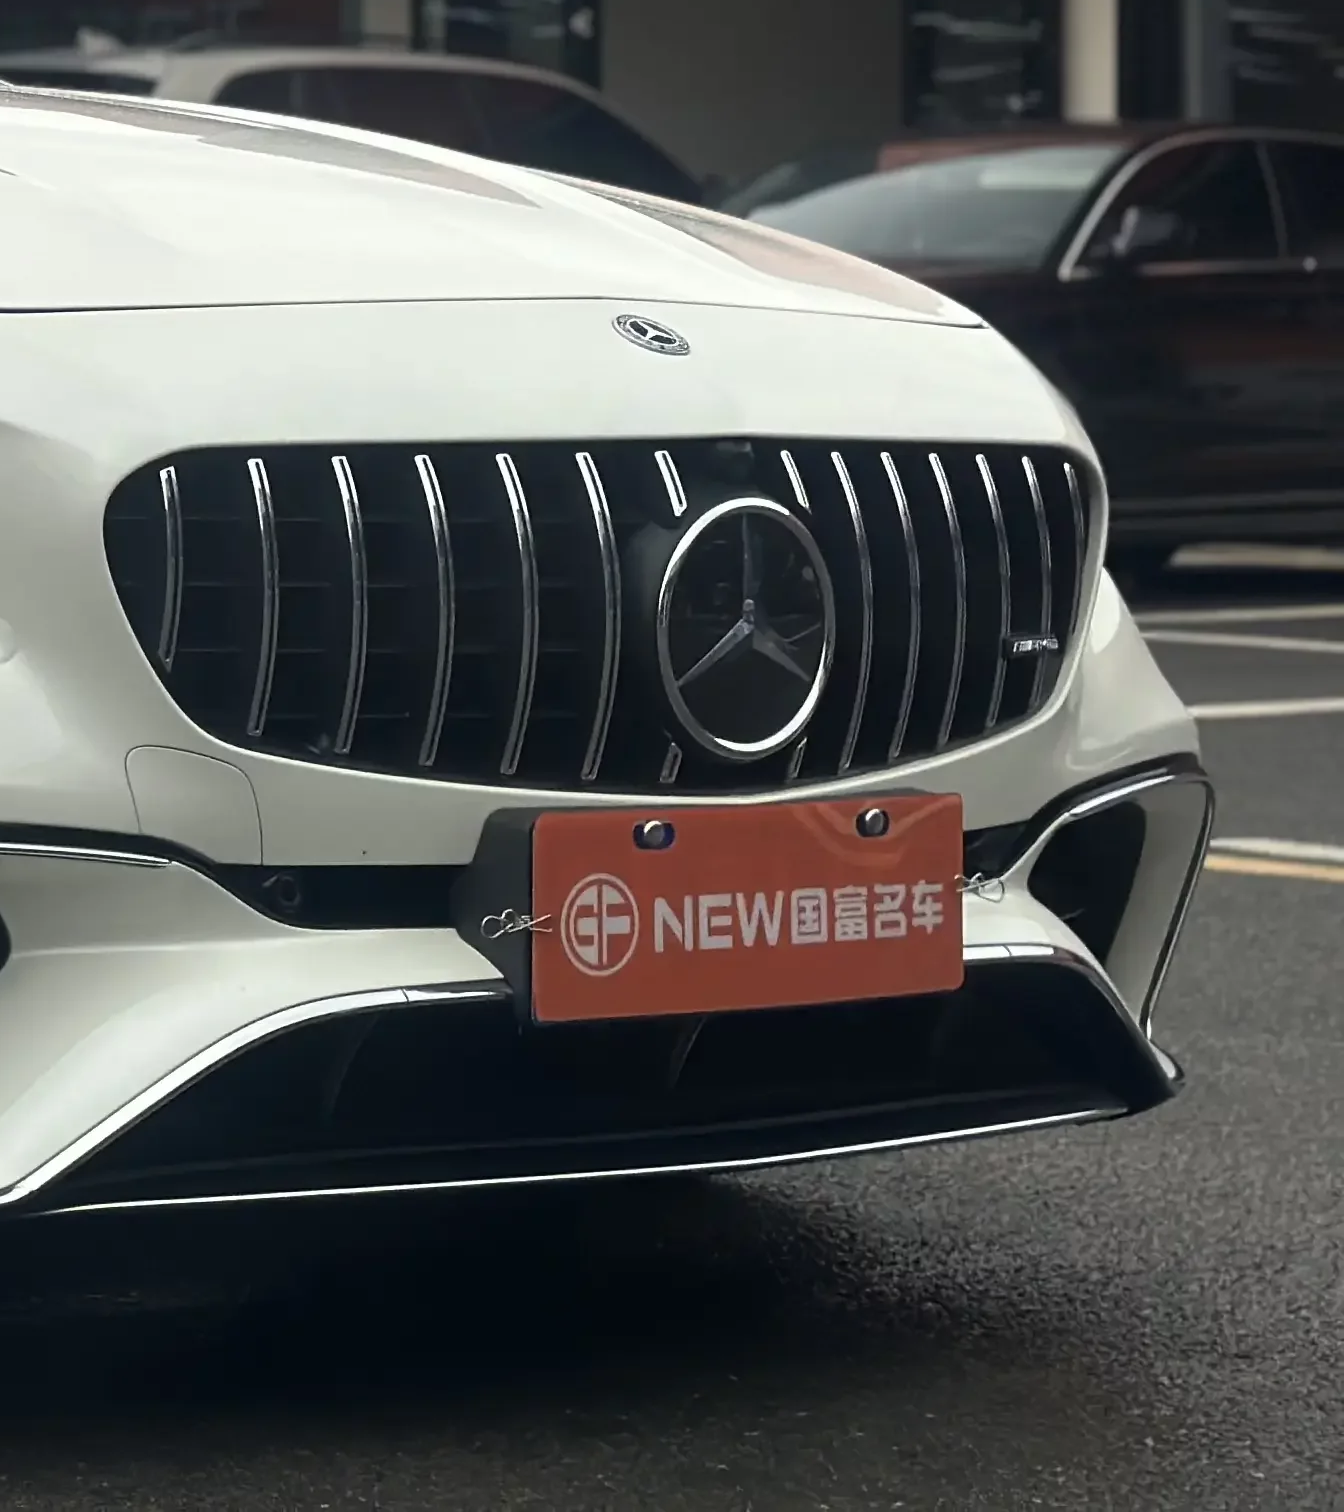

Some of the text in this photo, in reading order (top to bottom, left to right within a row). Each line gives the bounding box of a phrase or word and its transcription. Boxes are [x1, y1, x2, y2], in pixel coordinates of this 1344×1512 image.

[653, 889, 785, 954] NEW
[791, 879, 945, 945] 国富名车
